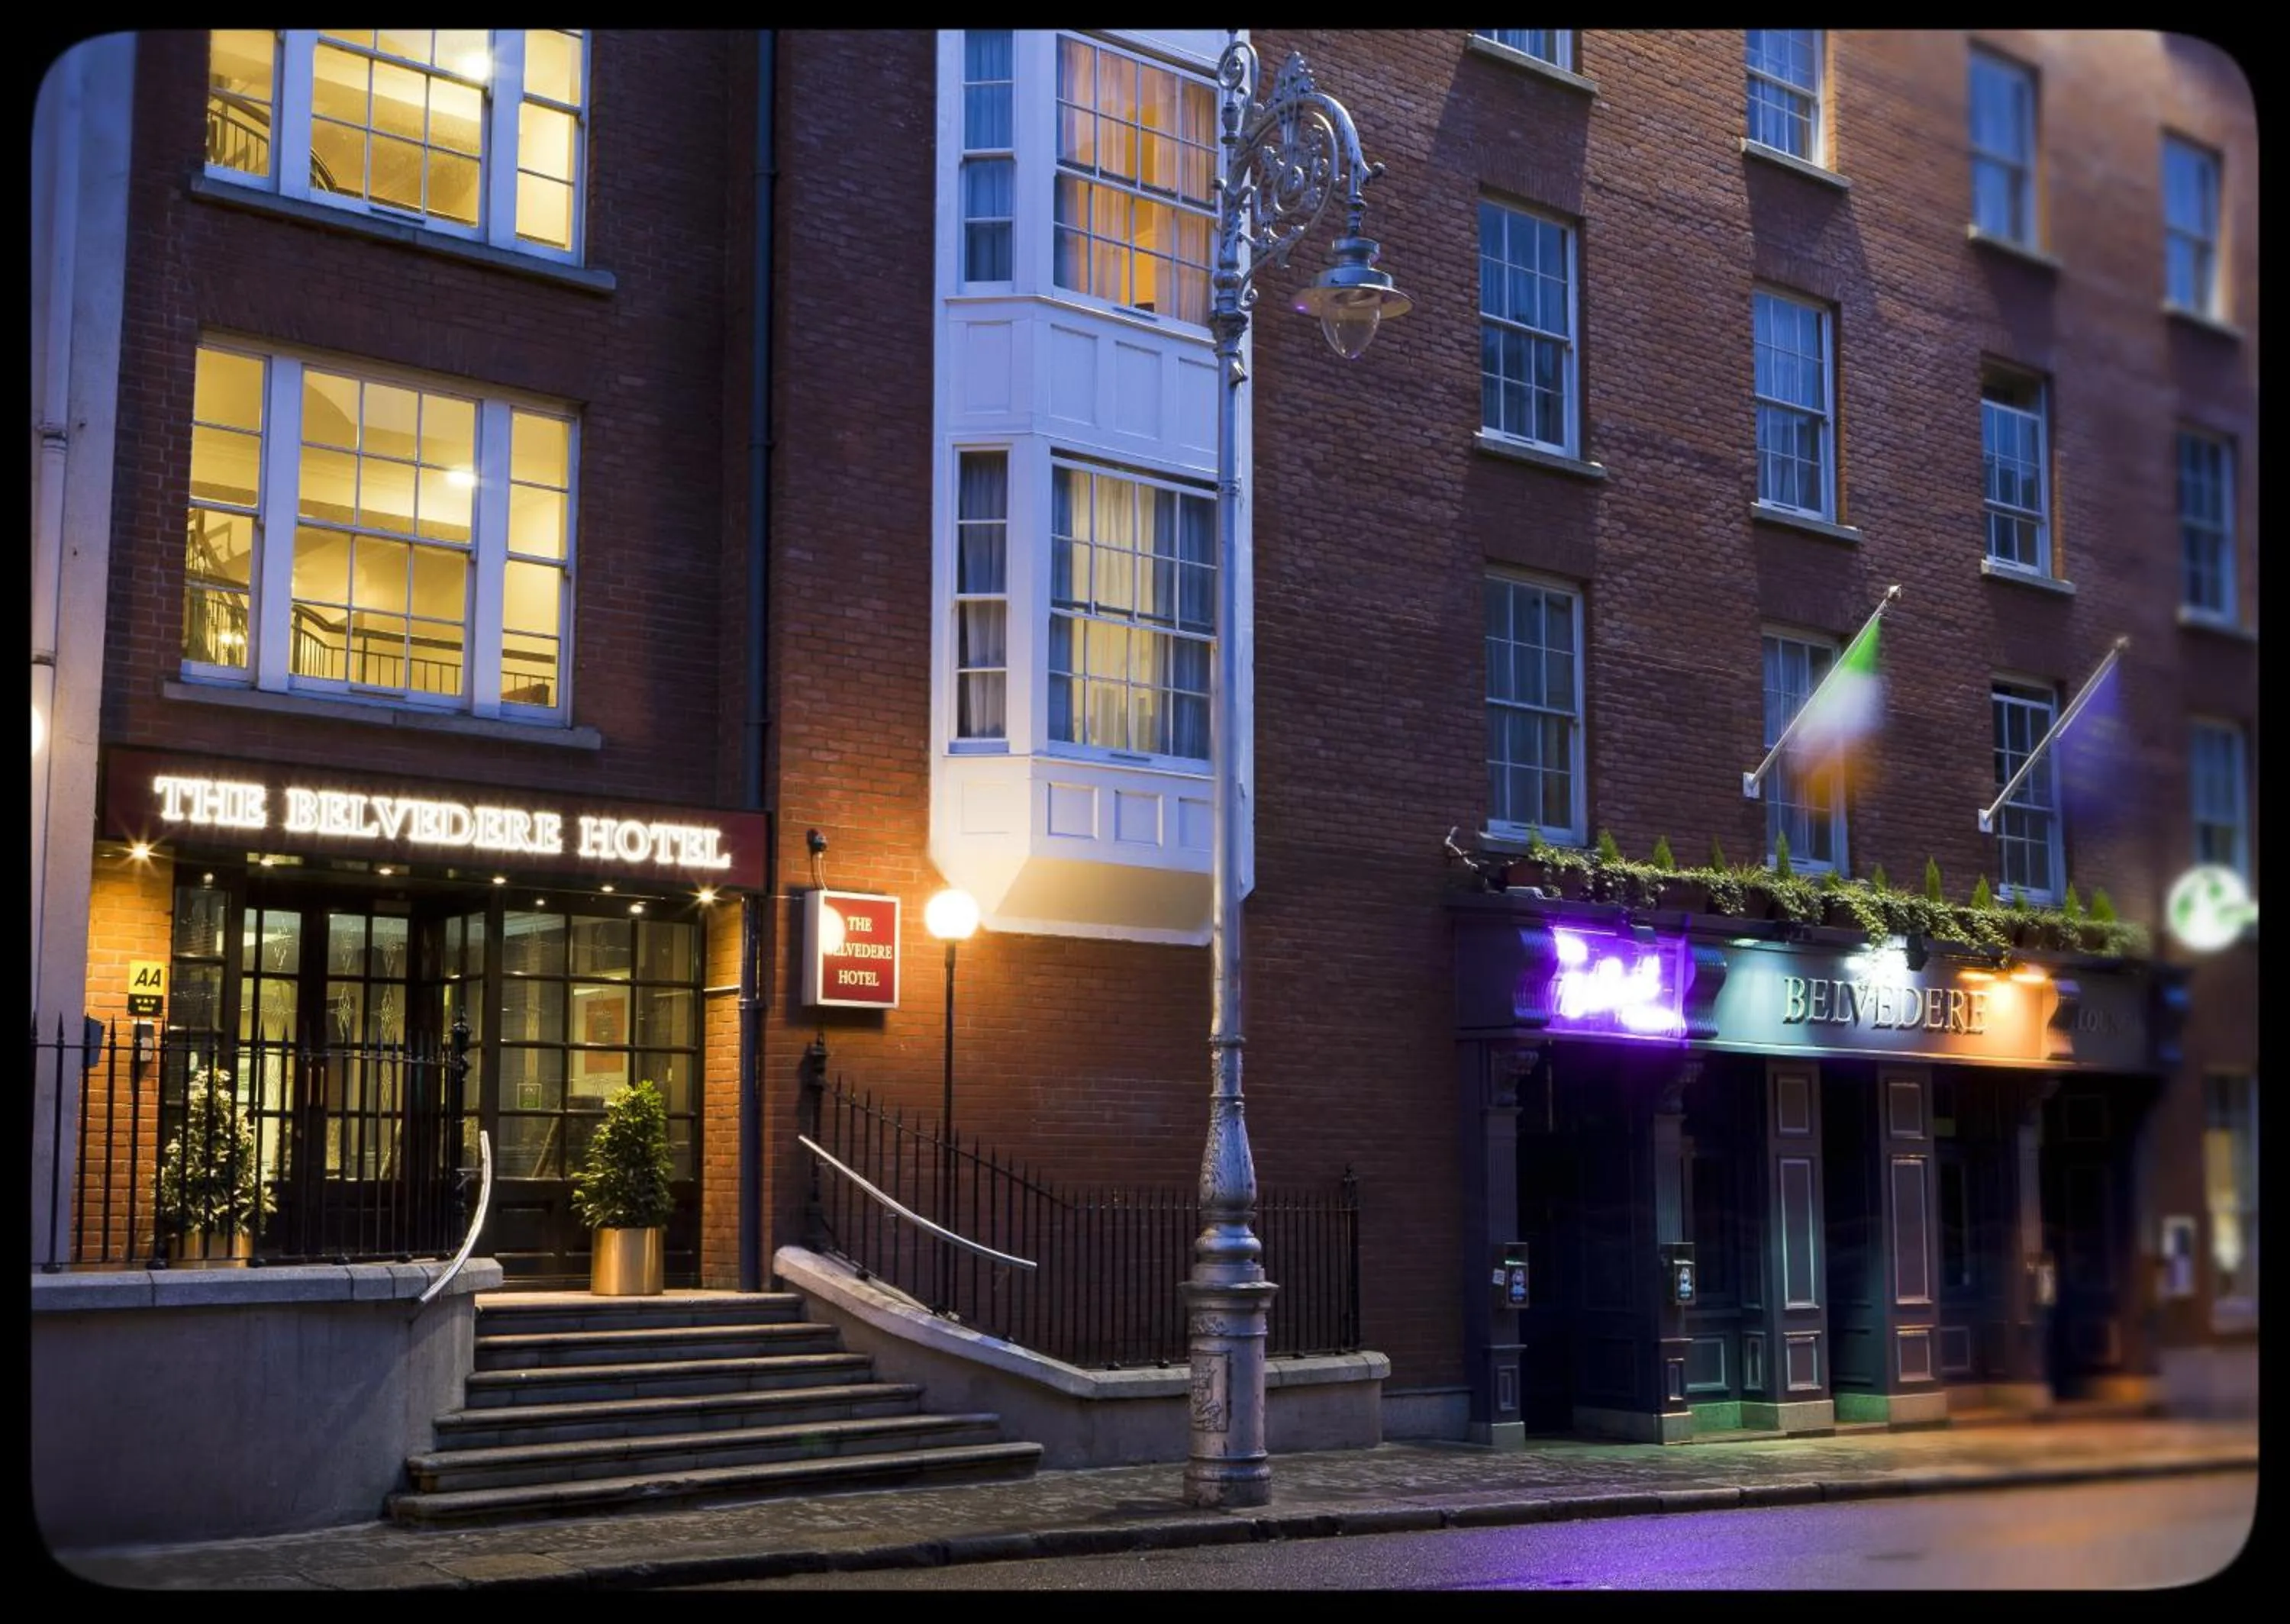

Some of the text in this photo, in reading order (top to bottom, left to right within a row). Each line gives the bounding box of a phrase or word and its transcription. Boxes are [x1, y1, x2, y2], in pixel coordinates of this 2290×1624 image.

[153, 776, 731, 869] THE BELVEDERE HOTEL
[847, 916, 872, 933] THE
[827, 942, 892, 959] LVEDERE
[134, 968, 161, 988] AA
[837, 969, 880, 987] HOTEL
[1782, 976, 1988, 1034] BELVEDERE
